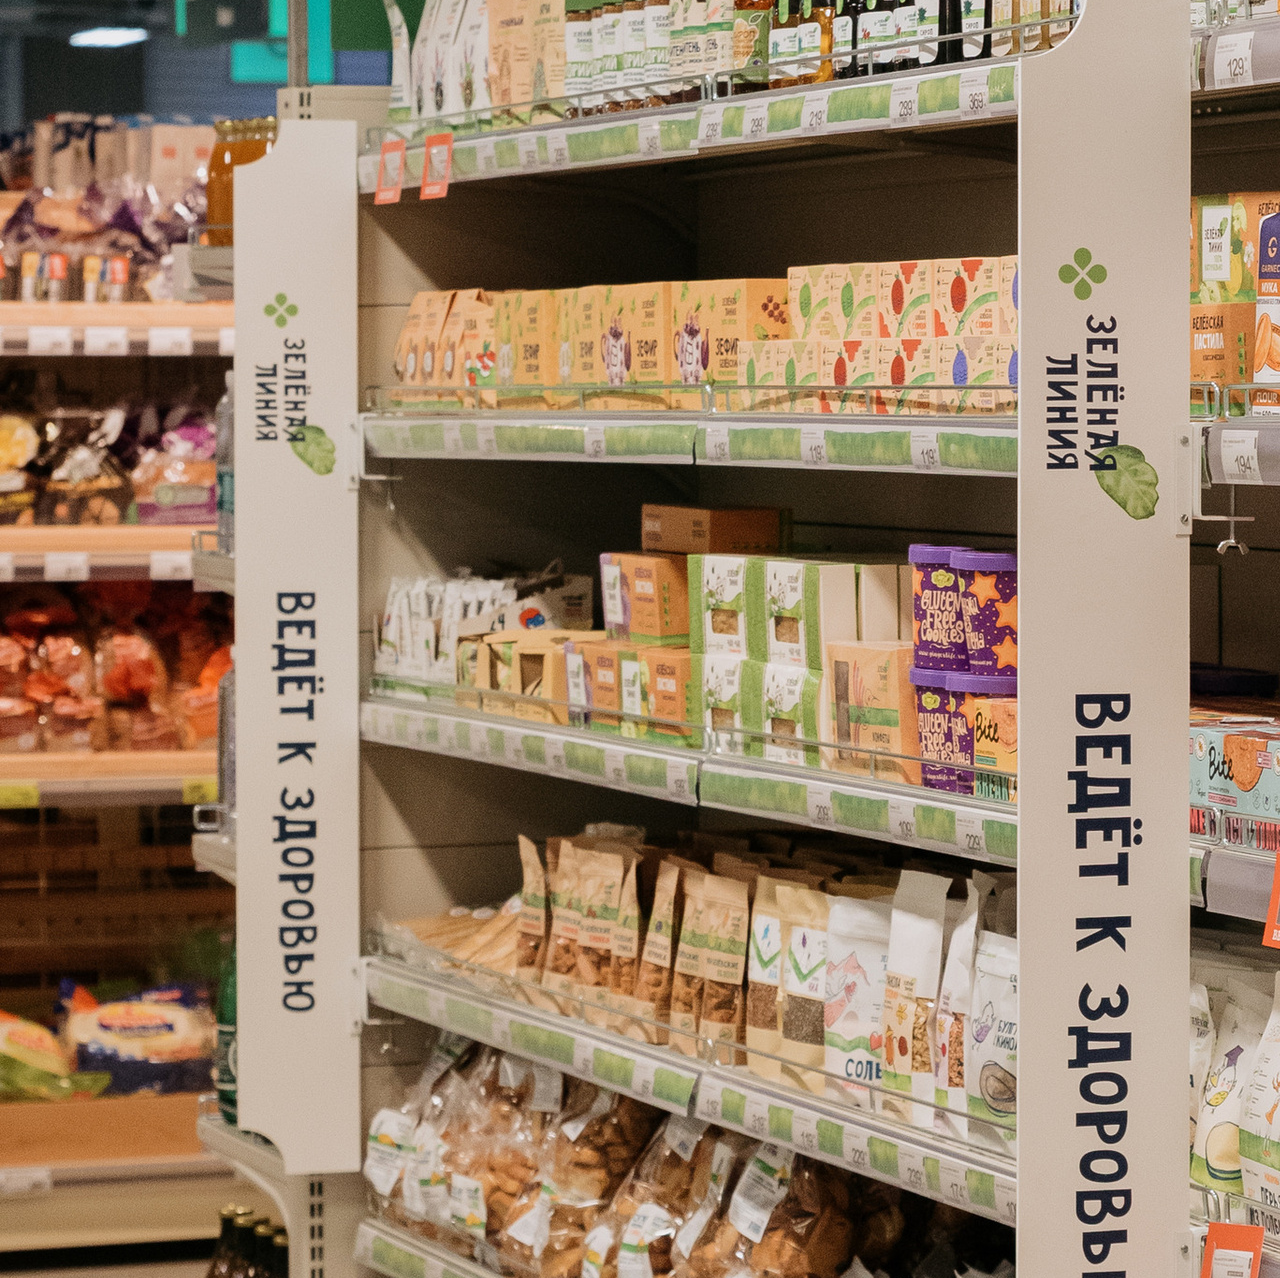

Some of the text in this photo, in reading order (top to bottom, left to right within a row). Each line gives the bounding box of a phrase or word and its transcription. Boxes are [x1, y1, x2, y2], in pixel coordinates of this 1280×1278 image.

[1261, 281, 1278, 293] МУКА
[254, 363, 278, 442] ЛИНИЯ
[283, 337, 308, 444] ЗЕЛЁНАЯ
[1045, 353, 1078, 471] ЛИНИЯ
[1084, 313, 1122, 472] ЗЕЛЁНАЯ
[975, 711, 999, 743] Bite
[1208, 745, 1234, 781] Bite
[271, 592, 323, 1011] ВЕДЁТ К ЗДОРОВЬЮ
[1067, 693, 1142, 886] ВЕДЁТ
[1075, 915, 1131, 951] К
